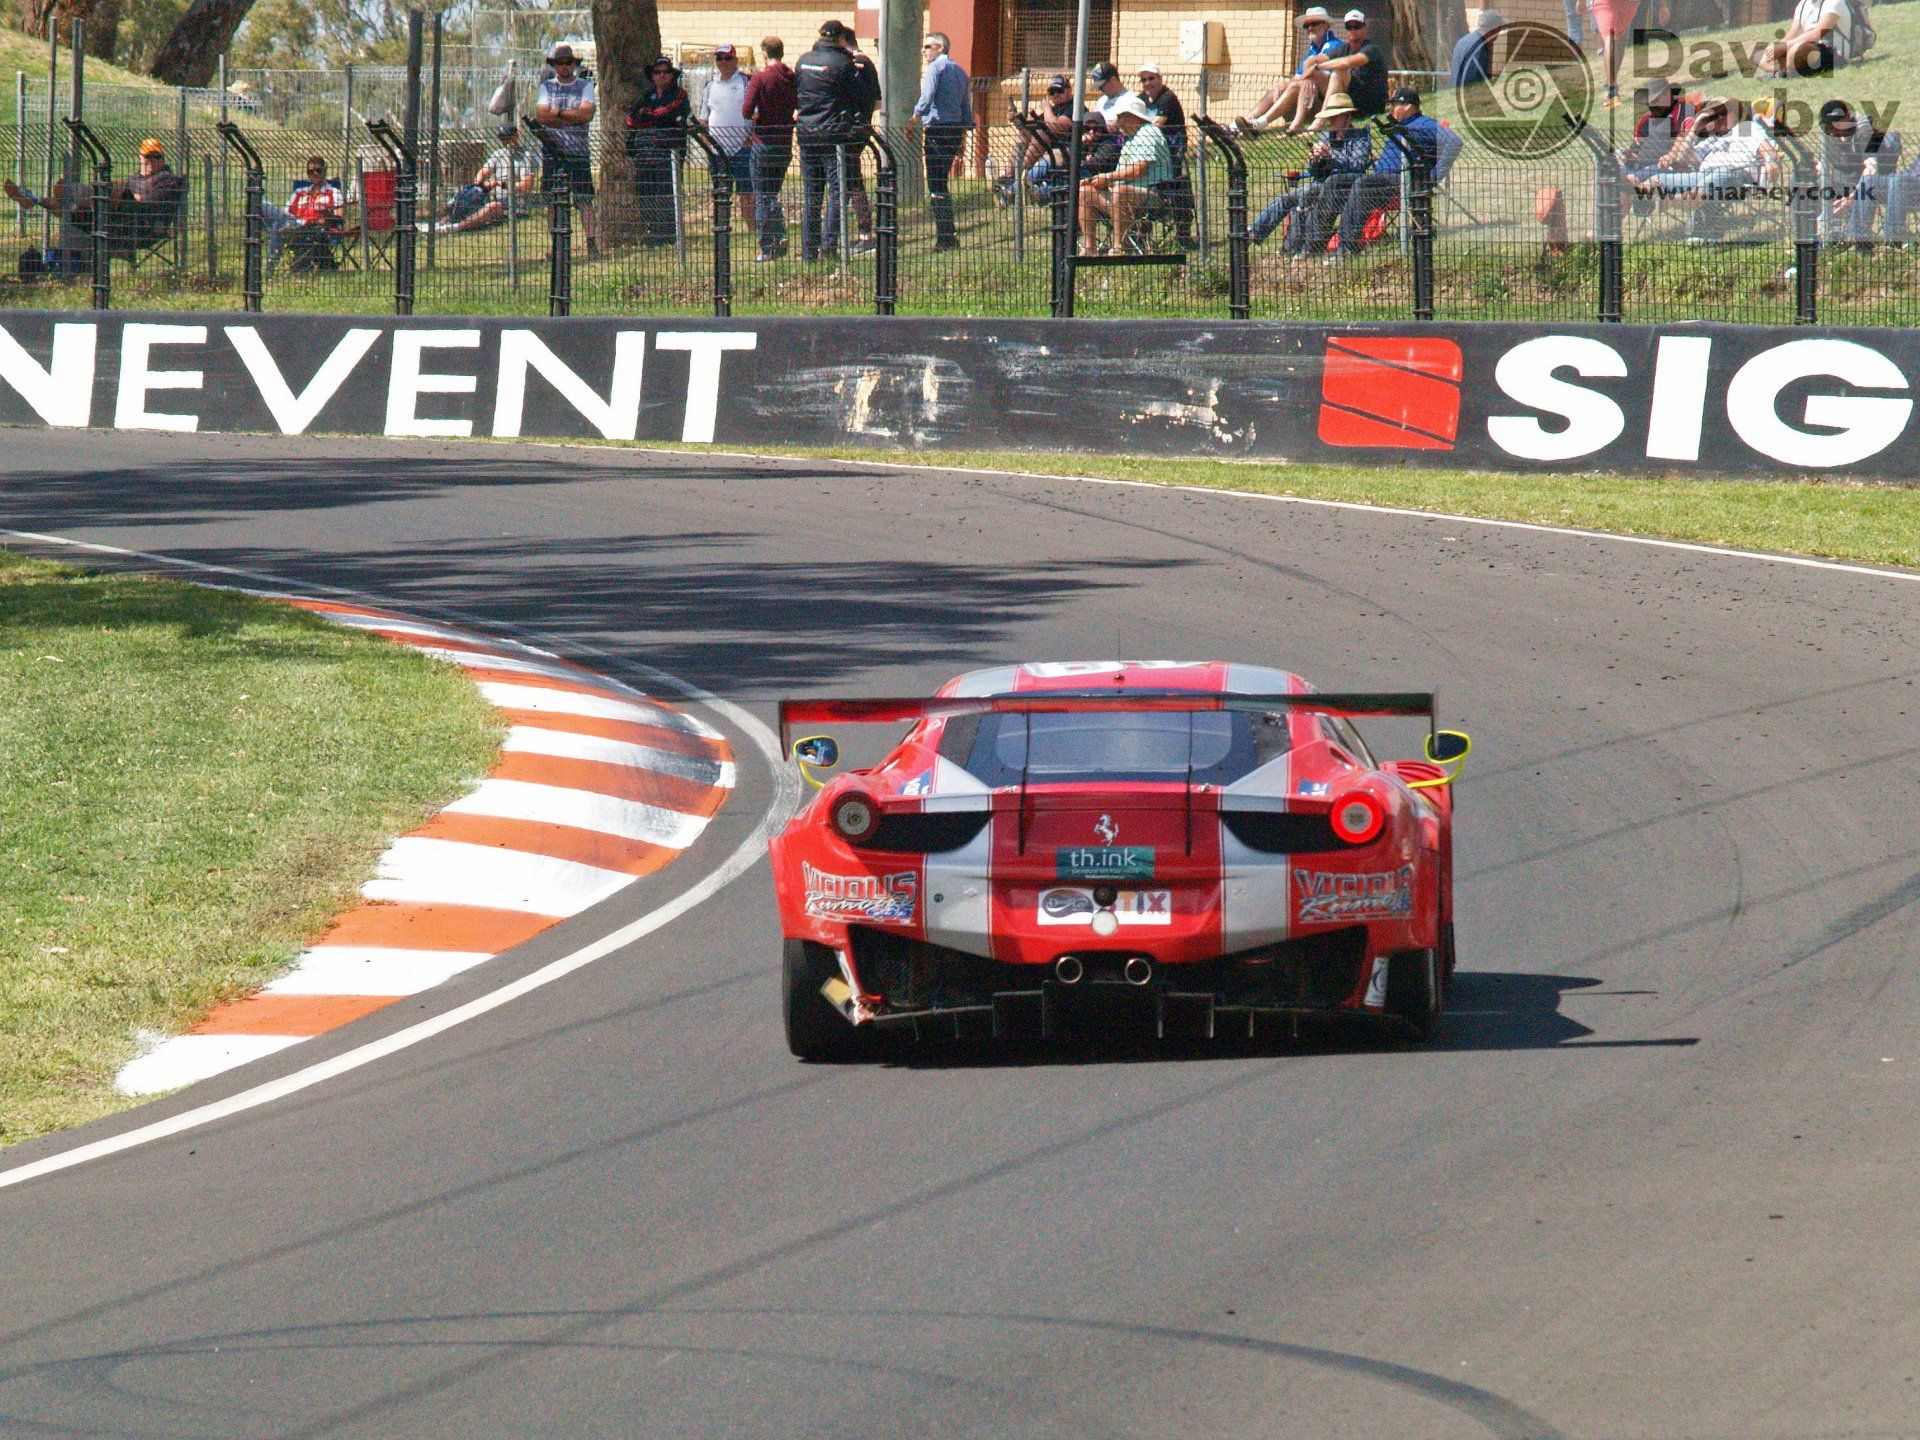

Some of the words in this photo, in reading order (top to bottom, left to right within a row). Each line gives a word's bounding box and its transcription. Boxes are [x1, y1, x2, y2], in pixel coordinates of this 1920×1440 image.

[1487, 335, 1914, 468] SIG
[1070, 847, 1138, 868] th.ink
[1101, 890, 1168, 914] TIX
